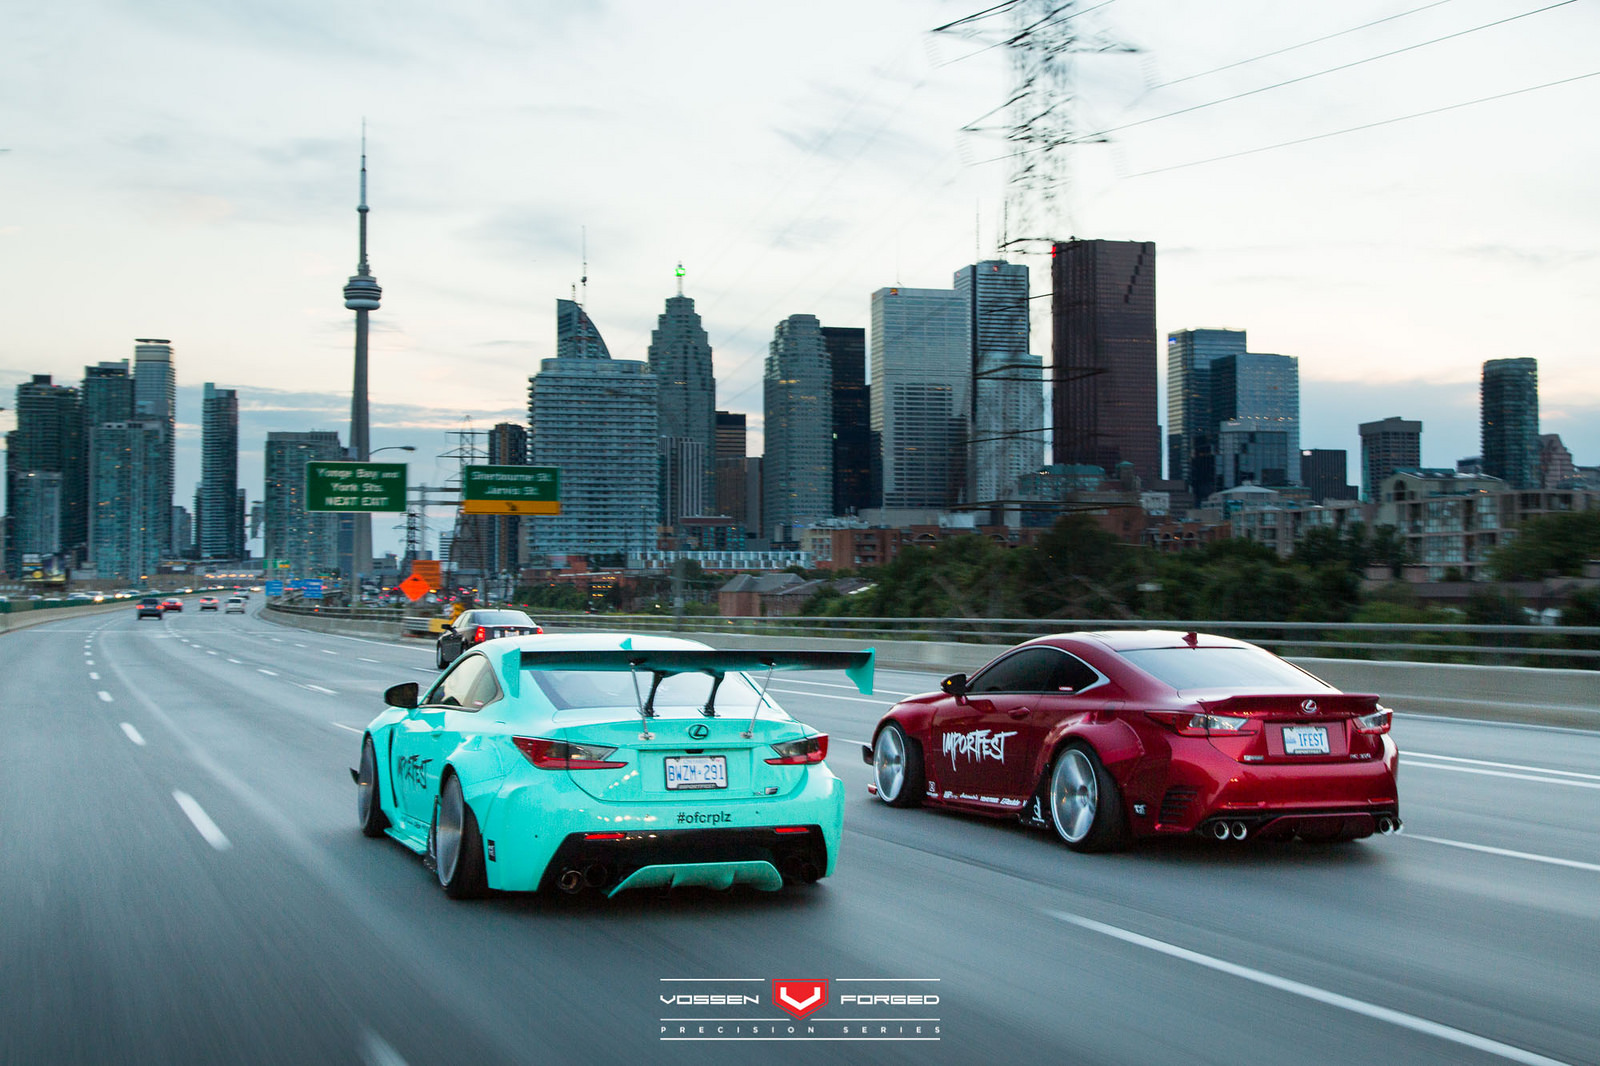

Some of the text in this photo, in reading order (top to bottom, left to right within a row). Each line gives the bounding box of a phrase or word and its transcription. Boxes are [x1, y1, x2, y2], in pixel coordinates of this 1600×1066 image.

[316, 468, 352, 480] Yonge
[355, 469, 378, 480] Bay
[331, 483, 358, 491] York
[325, 497, 389, 506] NEXT EXIT
[1298, 733, 1324, 747] IFEST
[677, 811, 732, 825] #ofcrplz
